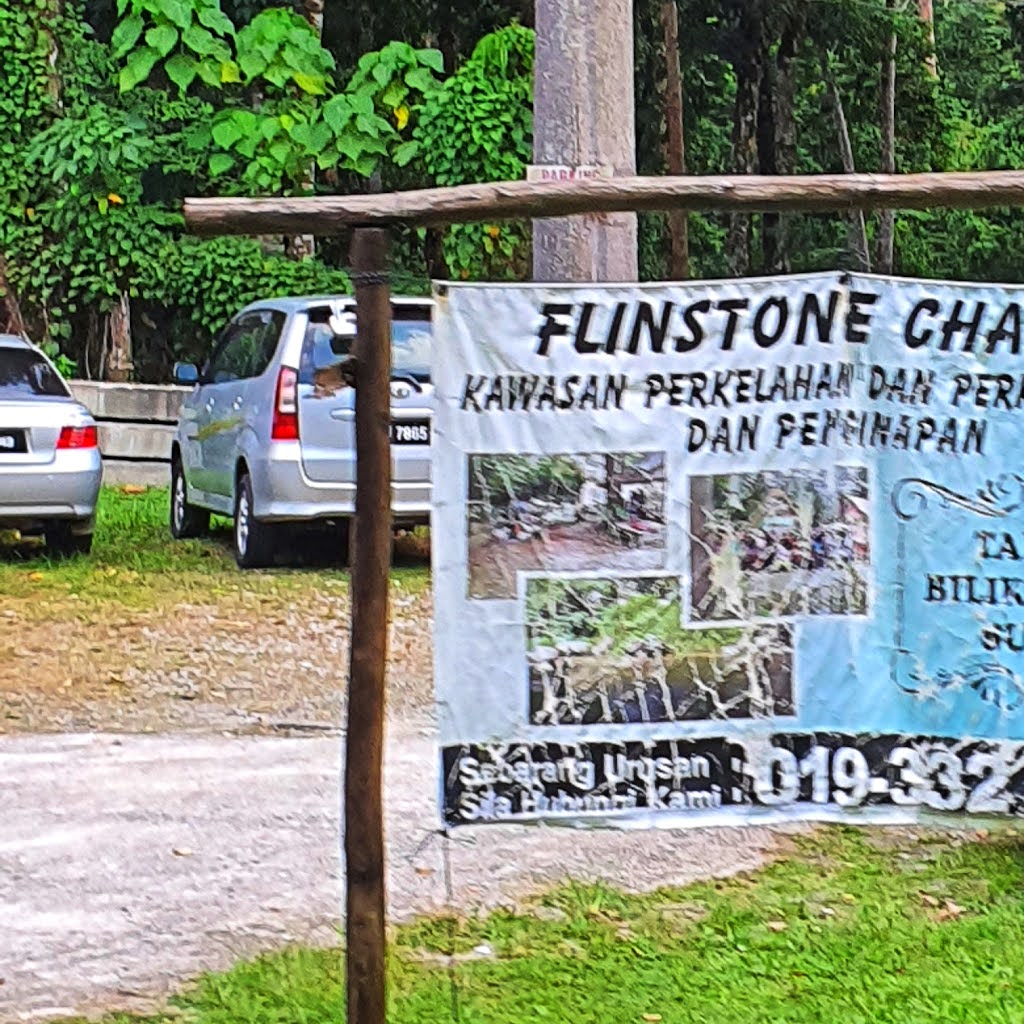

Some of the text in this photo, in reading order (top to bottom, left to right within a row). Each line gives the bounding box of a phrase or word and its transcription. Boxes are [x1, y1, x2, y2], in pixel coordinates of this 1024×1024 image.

[536, 290, 877, 356] FLINSTONE
[460, 373, 628, 413] KAWASAN
[643, 361, 853, 408] PERKELAHAN
[868, 363, 935, 405] DAN
[687, 413, 761, 454] DAN
